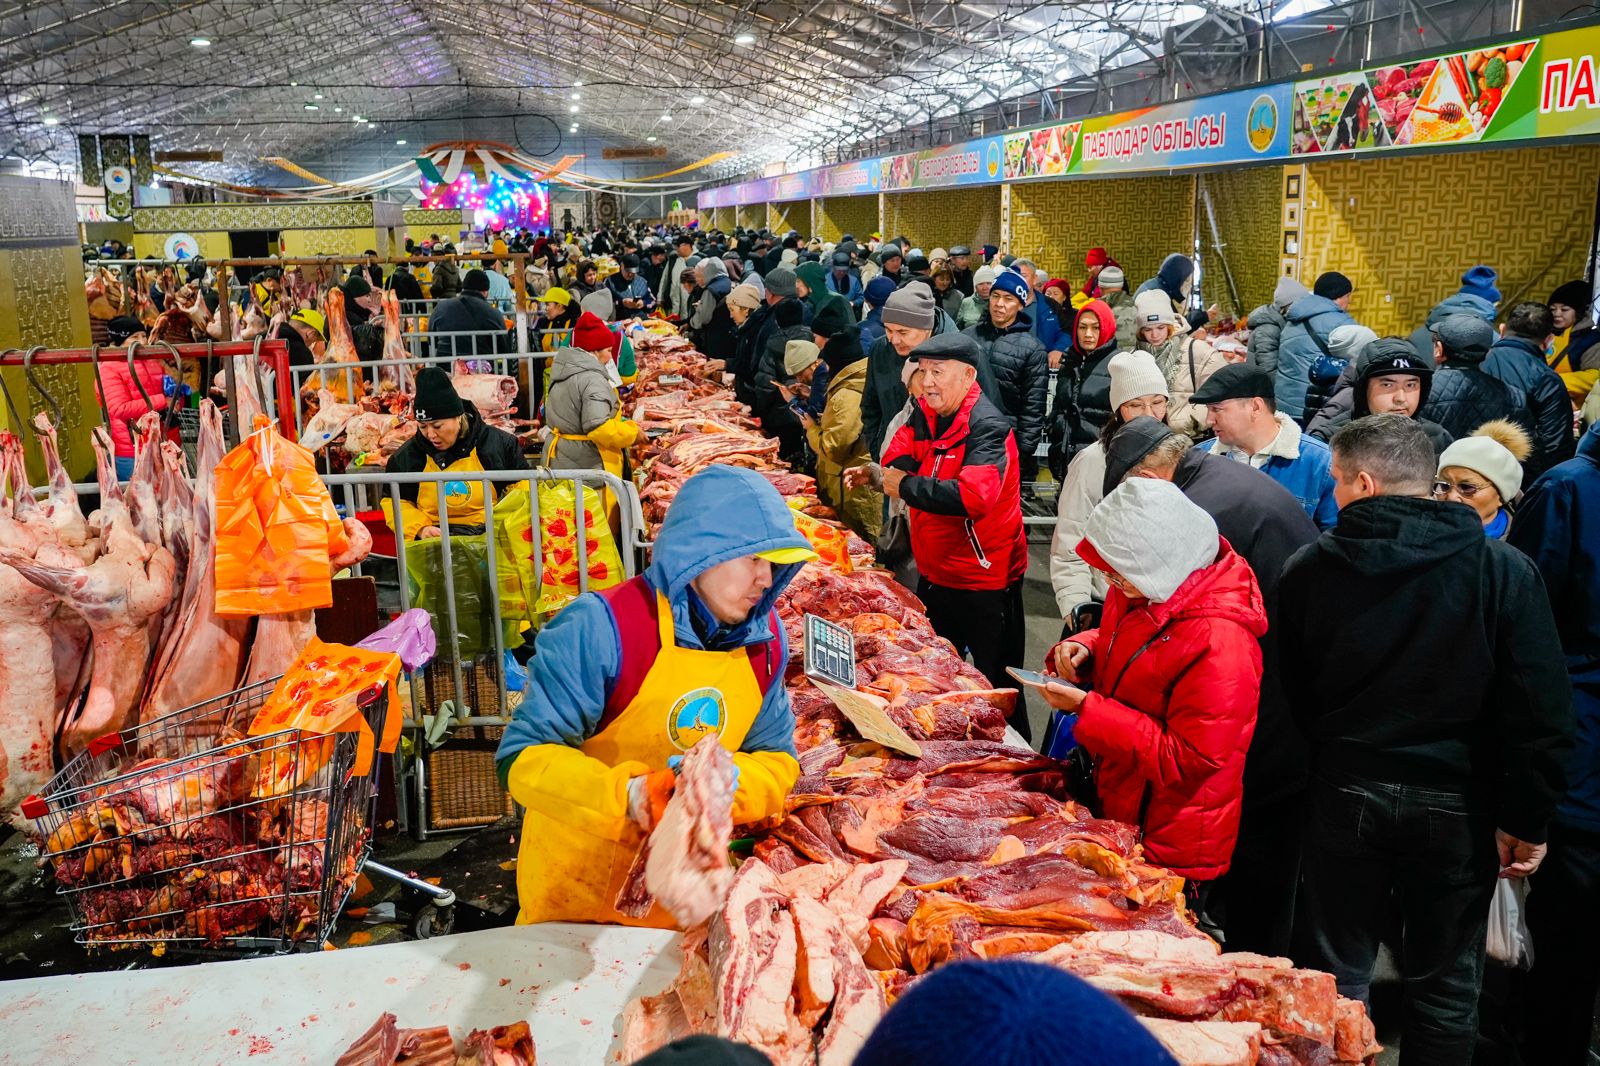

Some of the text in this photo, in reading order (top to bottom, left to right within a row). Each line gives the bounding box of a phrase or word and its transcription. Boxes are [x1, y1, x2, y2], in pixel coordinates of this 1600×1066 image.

[1542, 57, 1600, 111] ПА
[1082, 114, 1225, 160] ПАВЛОДАР ОБЛЫСЫ
